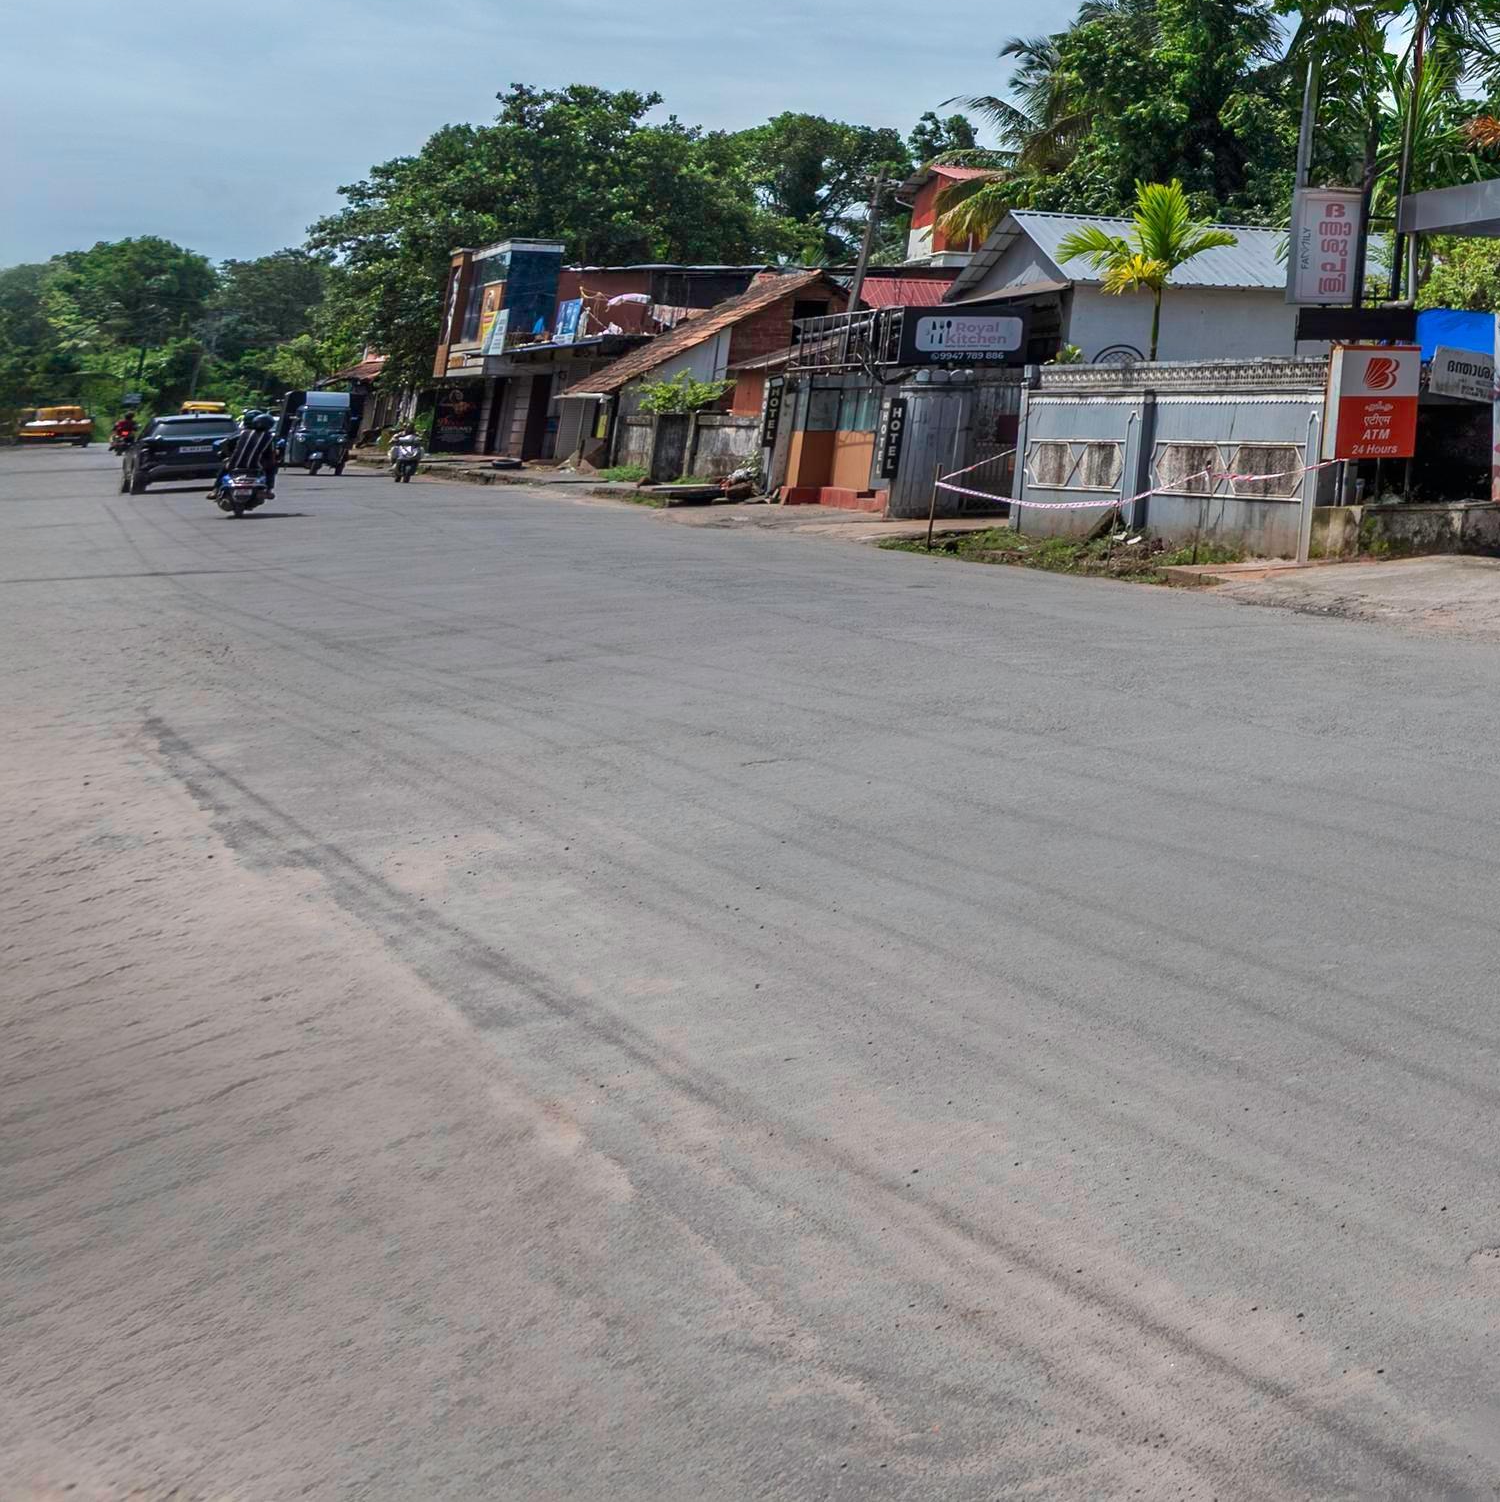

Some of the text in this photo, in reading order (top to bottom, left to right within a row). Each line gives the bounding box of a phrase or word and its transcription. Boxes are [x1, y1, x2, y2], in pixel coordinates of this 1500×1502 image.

[956, 322, 999, 334] Royal
[945, 334, 1006, 344] Kitchen
[940, 352, 964, 360] 9947
[767, 388, 780, 440] HOTEL
[1364, 413, 1392, 426] एटीएम
[887, 408, 902, 469] HOTEL
[1362, 429, 1390, 440] ATM
[1352, 444, 1398, 455] 24 Hours
